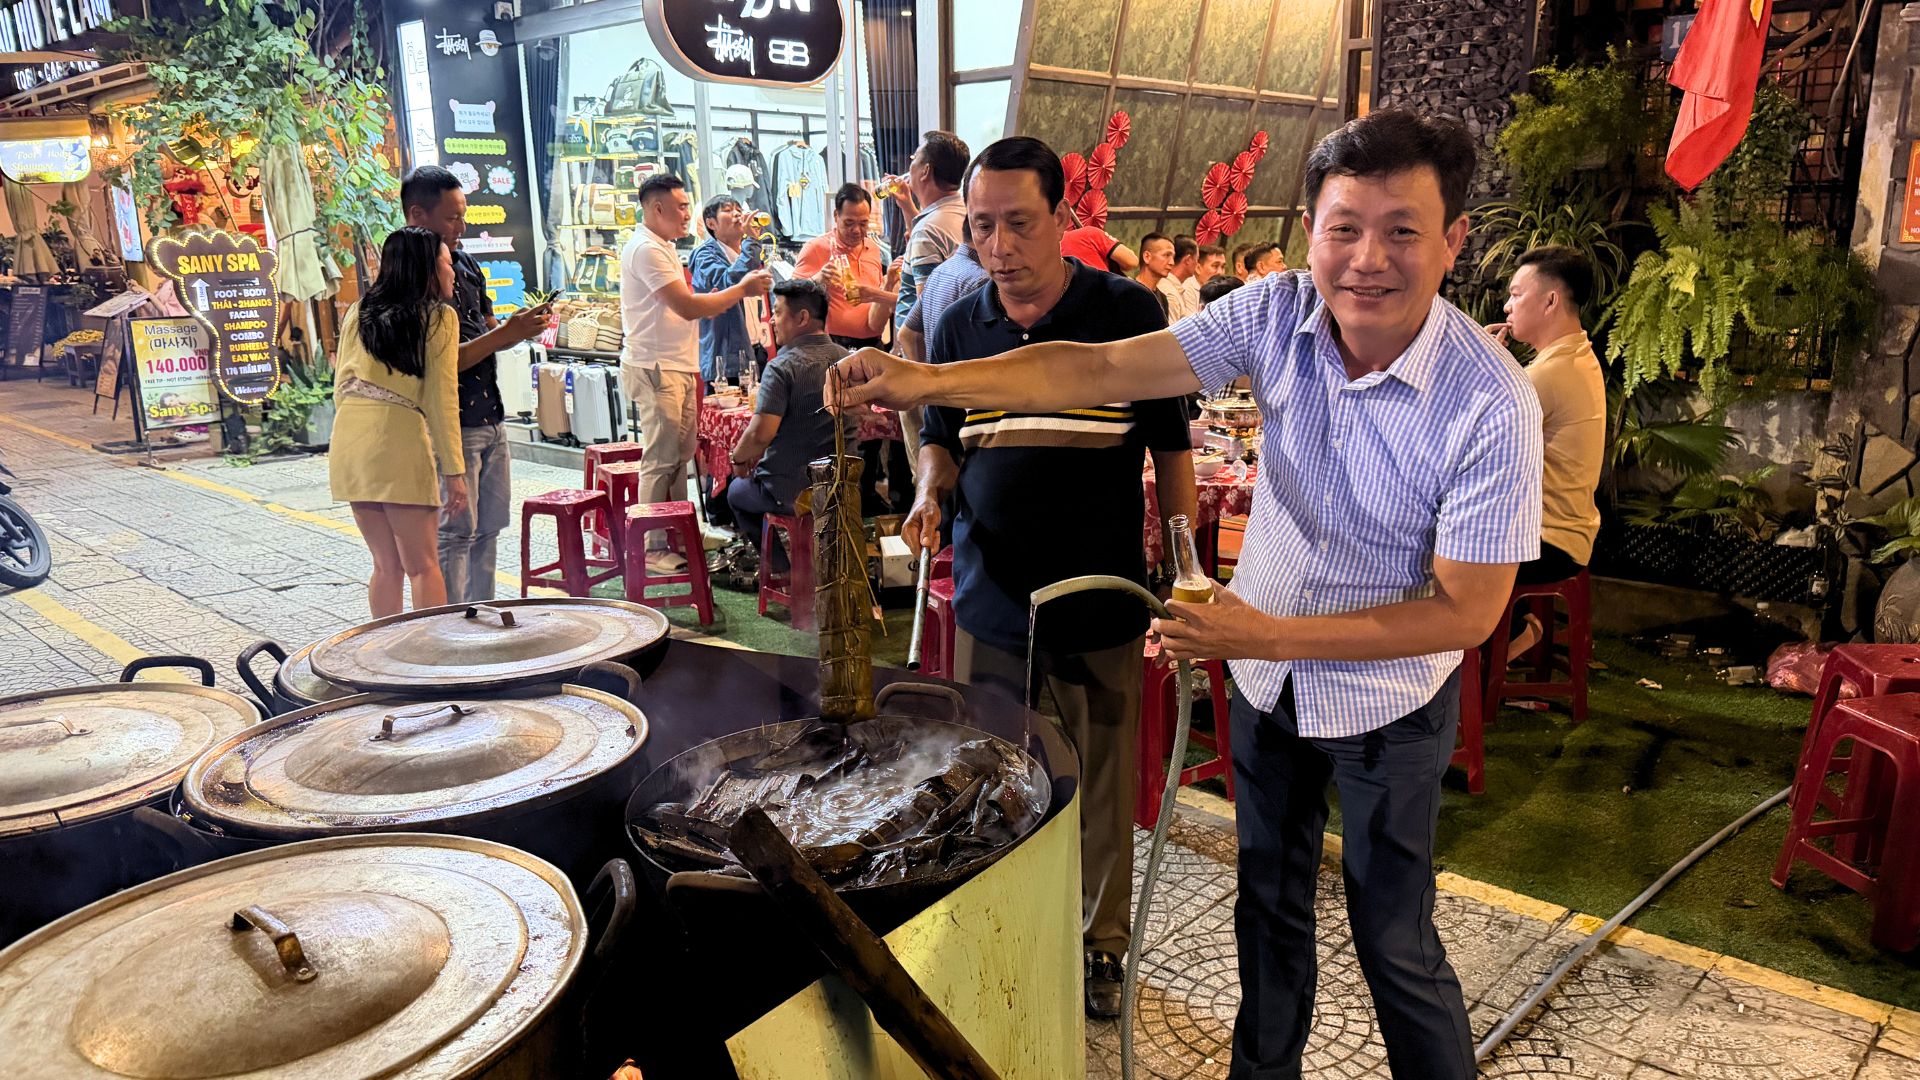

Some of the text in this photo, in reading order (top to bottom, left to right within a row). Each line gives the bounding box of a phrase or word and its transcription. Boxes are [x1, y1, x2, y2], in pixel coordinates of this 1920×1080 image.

[1669, 20, 1694, 49] 1
[491, 177, 511, 185] SALE
[178, 252, 261, 275] SANY SPA
[214, 290, 237, 299] FOOT
[243, 288, 267, 298] BODY
[211, 299, 233, 310] THÁI
[238, 298, 273, 309] 2HANDS
[229, 310, 260, 320] FACIAL
[144, 324, 198, 337] Massage
[224, 320, 268, 331] SHAMPOO
[230, 331, 265, 341] COMBO
[149, 336, 198, 352] (마사지)
[146, 356, 208, 374] 140.000
[148, 402, 218, 419] Sany Spa
